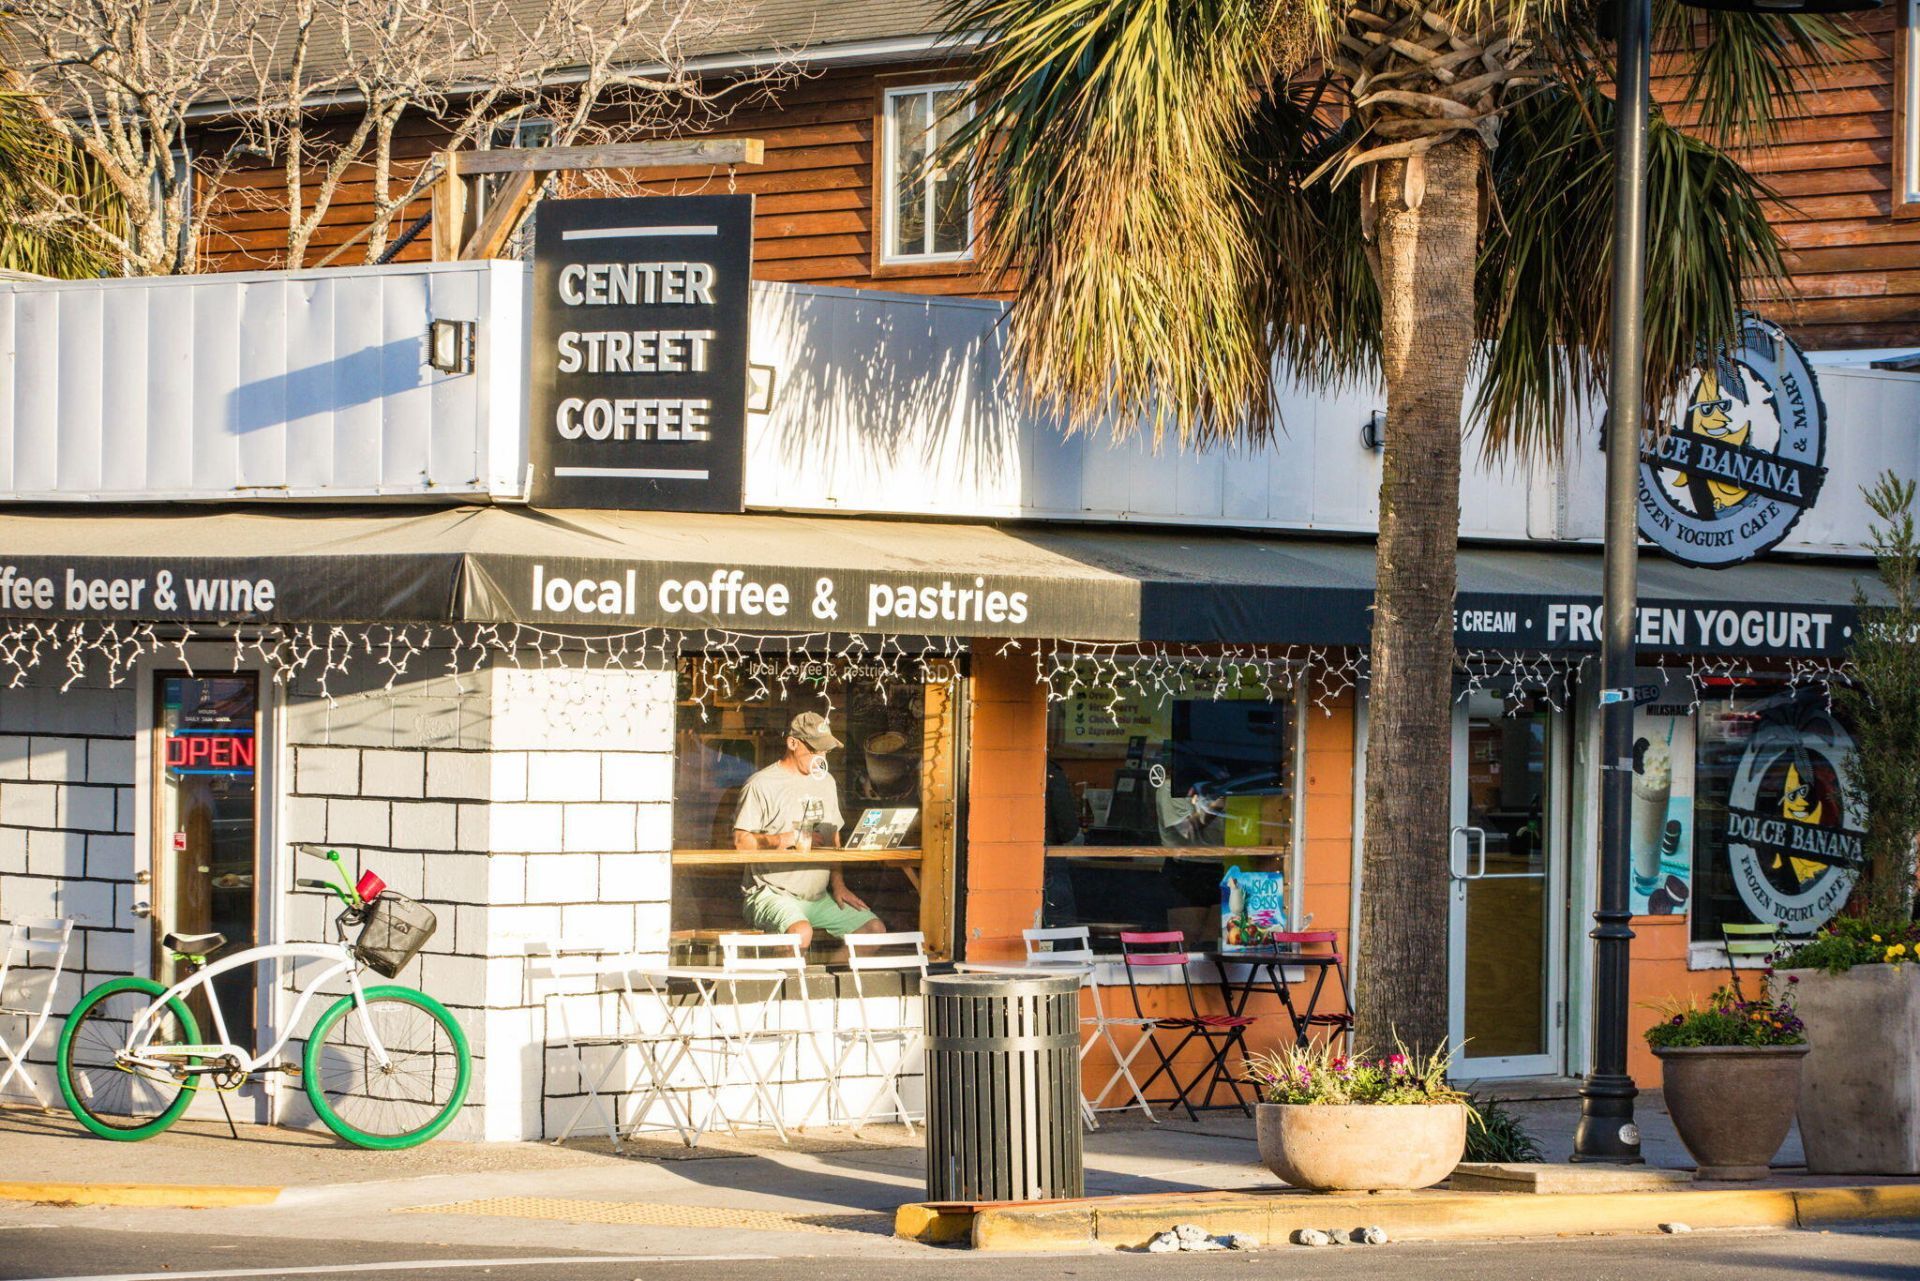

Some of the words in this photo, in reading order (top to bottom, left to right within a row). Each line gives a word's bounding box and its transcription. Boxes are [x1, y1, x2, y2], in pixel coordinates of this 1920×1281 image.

[558, 262, 716, 305] CENTER
[557, 330, 715, 373] STREET
[556, 398, 712, 441] COFFEE
[1779, 372, 1808, 429] MART
[1639, 427, 1691, 465] LCE
[1696, 443, 1802, 498] BANANA
[1793, 438, 1807, 452] &
[1676, 523, 1735, 548] YOGURT
[1740, 501, 1780, 539] CAFE
[0, 565, 54, 609] fee
[66, 568, 145, 611] beer
[154, 569, 177, 611] &
[185, 577, 275, 612] wine
[532, 565, 636, 614] local
[658, 569, 789, 617] coffee
[811, 577, 838, 619] &
[868, 577, 1028, 626] pastries
[1462, 610, 1516, 632] CREAM
[1547, 604, 1685, 646] FREN
[1694, 609, 1832, 650] YOGURT
[749, 661, 778, 675] local
[1633, 687, 1658, 701] REO
[165, 737, 255, 767] OPEN
[1728, 813, 1787, 847] DOLCE
[1791, 825, 1864, 862] BANANA
[1251, 895, 1278, 910] OASIS
[1741, 854, 1772, 910] FROZEN
[1774, 903, 1814, 922] YOGURT
[1818, 876, 1845, 912] CAFE
